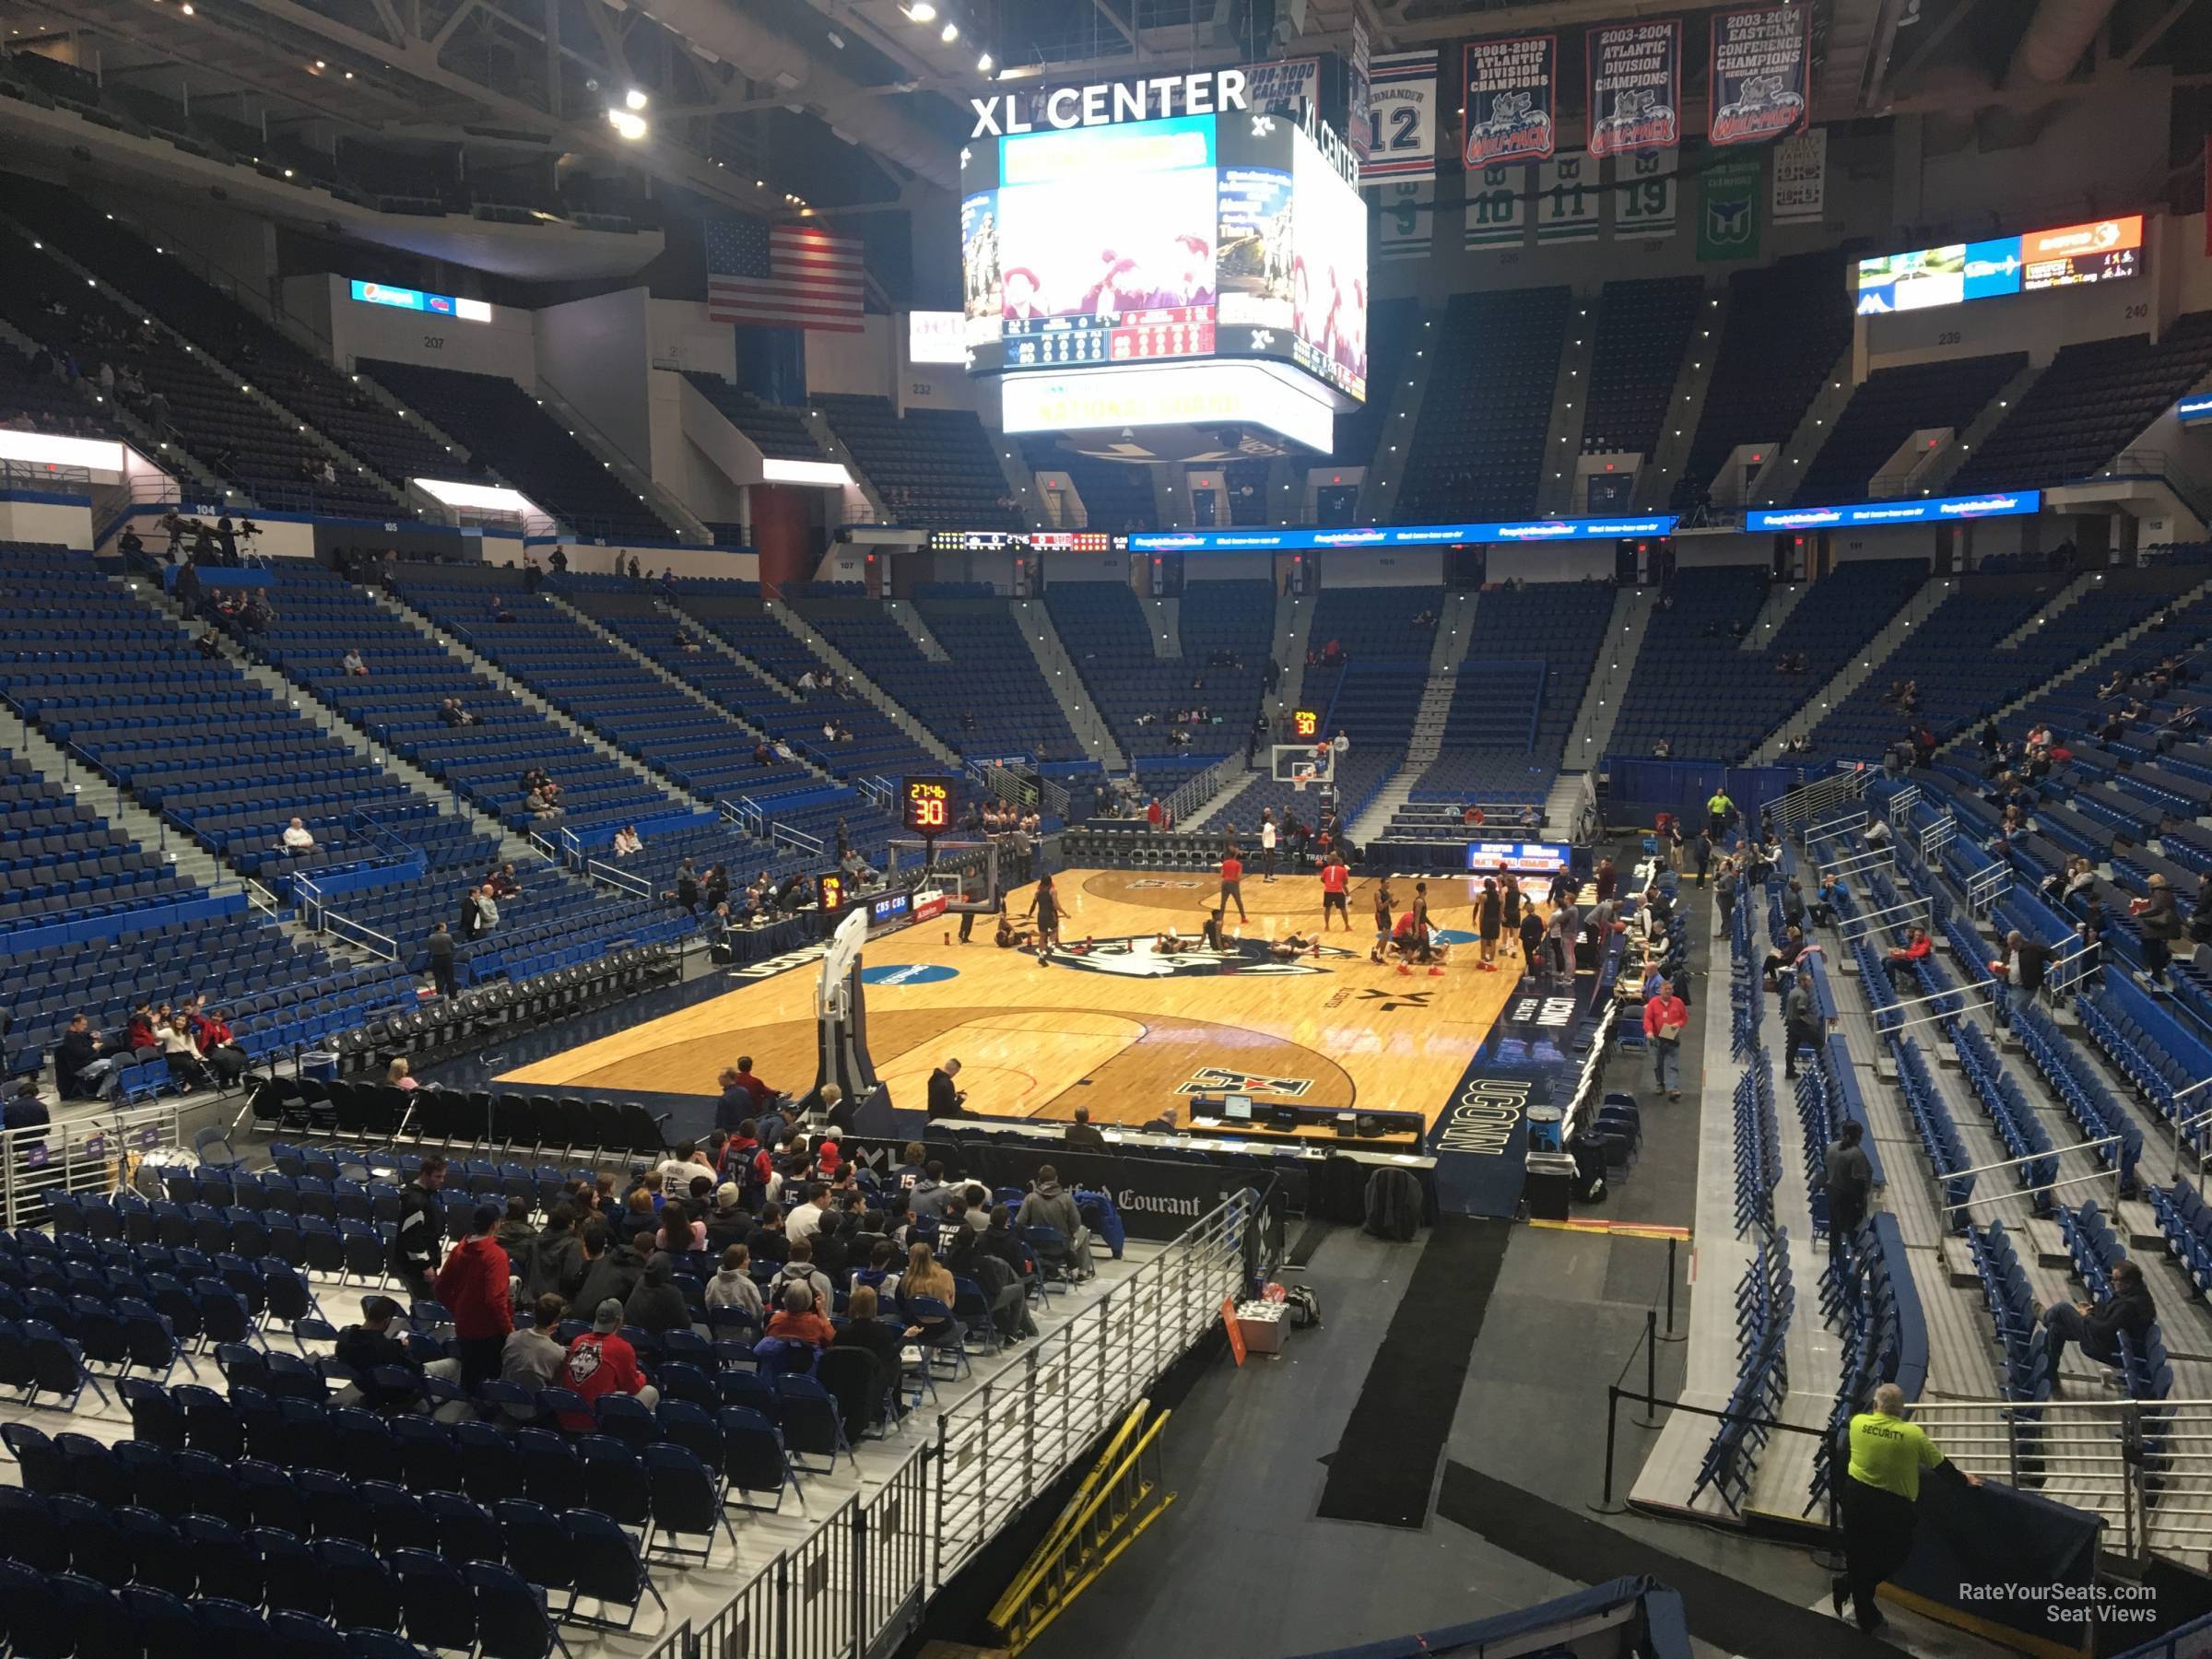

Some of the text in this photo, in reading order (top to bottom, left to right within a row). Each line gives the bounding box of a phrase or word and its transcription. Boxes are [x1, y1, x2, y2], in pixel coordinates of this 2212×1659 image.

[1726, 9, 1800, 29] 2003-2004
[1600, 24, 1672, 44] 2003-2004
[1729, 23, 1795, 41] EASTERN
[1474, 40, 1547, 57] 2008-2009
[1603, 41, 1666, 59] ATLANTIC
[1718, 36, 1802, 56] CONFERENCE
[1477, 52, 1543, 69] ATLANTIC
[1605, 56, 1661, 74] DIVISION
[1717, 51, 1801, 70] CHAMPIONS
[1479, 64, 1539, 80] DIVISION
[1595, 71, 1668, 91] CHAMPIONS
[1470, 75, 1548, 92] CHAMPIONS
[971, 70, 1247, 137] XL CENTER
[1370, 106, 1420, 152] 12
[1322, 120, 1359, 195] CENTER
[1476, 189, 1514, 224] 10
[1551, 182, 1585, 218] 11
[1625, 181, 1667, 218] 19
[2124, 303, 2147, 319] 240
[424, 336, 444, 350] 207
[1939, 332, 1960, 346] 239
[912, 383, 931, 394] 232
[196, 504, 216, 515] 104
[383, 523, 397, 532] 105
[1299, 720, 1314, 734] 30
[911, 784, 946, 799] 27:46
[916, 800, 943, 825] 30
[876, 897, 906, 913] CBS CBS
[1536, 997, 1576, 1026] UCONN
[1437, 1079, 1532, 1155] UCONN
[900, 1173, 916, 1189] 15
[785, 1189, 799, 1204] 15
[1116, 1188, 1200, 1217] Courant
[937, 1234, 954, 1254] 15
[1862, 1424, 1904, 1441] SECURITY
